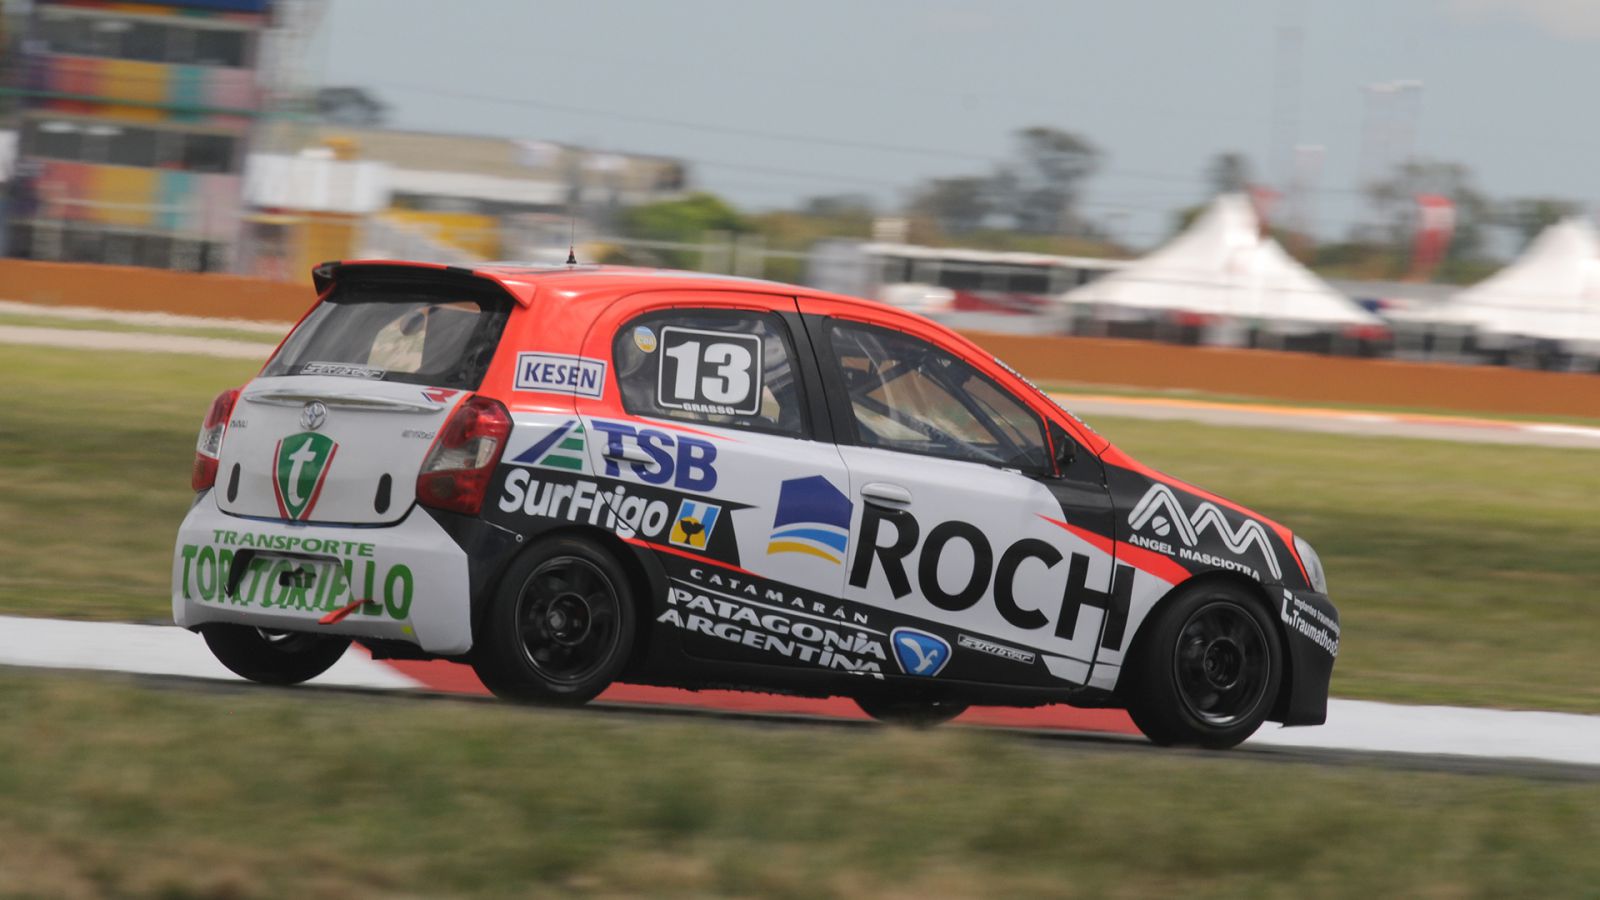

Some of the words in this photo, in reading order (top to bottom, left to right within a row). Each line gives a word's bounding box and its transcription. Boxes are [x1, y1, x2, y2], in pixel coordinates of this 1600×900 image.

[524, 362, 598, 389] KESEN
[666, 340, 752, 405] 13
[682, 402, 735, 415] GRASSO
[590, 419, 718, 493] TSB
[499, 468, 669, 539] SurFrigo
[212, 529, 376, 557] TRANSPORTE
[1128, 534, 1176, 556] ANGEL
[1179, 548, 1261, 582] MASCIOTRA
[690, 568, 869, 625] CATAMARÁN
[848, 499, 1136, 652] ROCH
